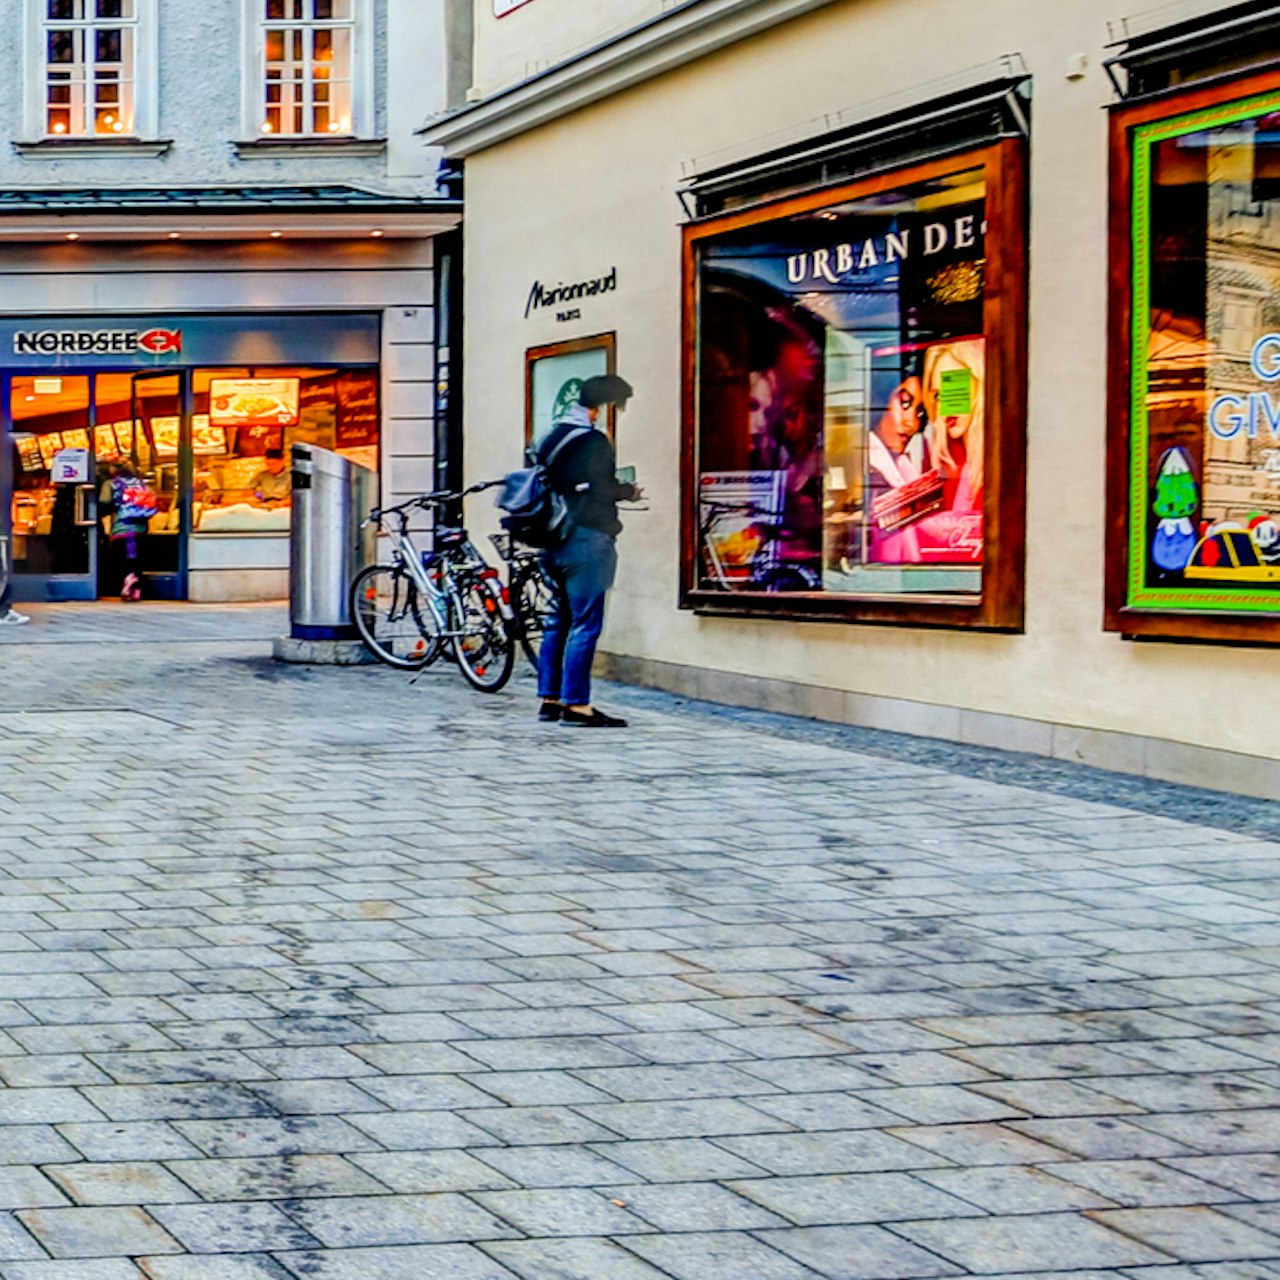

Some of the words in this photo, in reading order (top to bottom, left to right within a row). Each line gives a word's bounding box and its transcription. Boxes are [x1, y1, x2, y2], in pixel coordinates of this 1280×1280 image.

[787, 229, 910, 284] URBAN
[922, 214, 988, 256] DE
[523, 265, 616, 320] Marionnaud
[14, 330, 139, 354] NORDSEE
